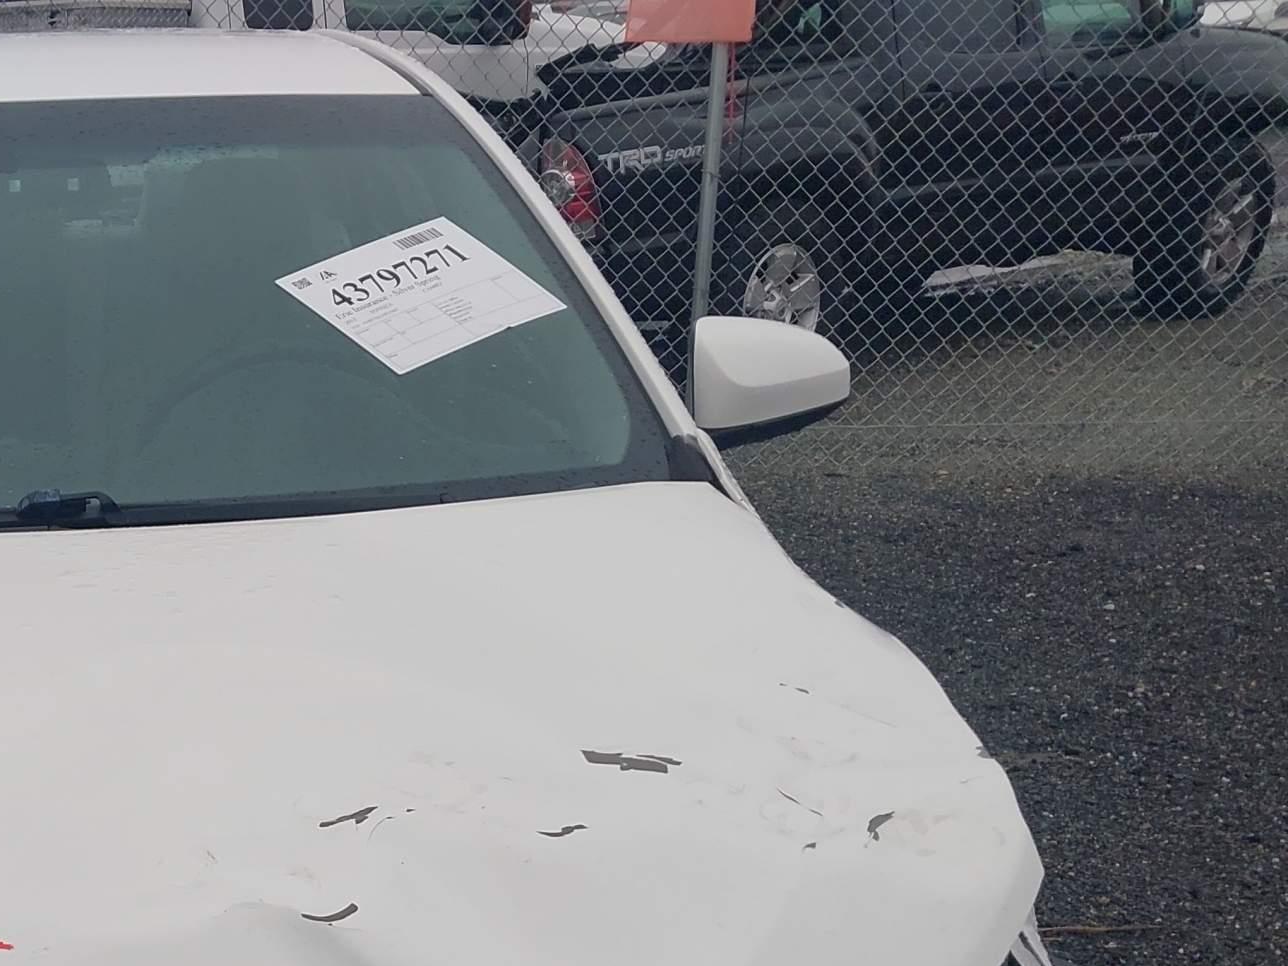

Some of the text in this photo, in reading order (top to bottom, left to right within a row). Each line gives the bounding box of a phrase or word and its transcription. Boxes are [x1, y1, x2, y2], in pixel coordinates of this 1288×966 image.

[598, 144, 705, 175] TRD SPOR
[332, 244, 470, 306] 43797271
